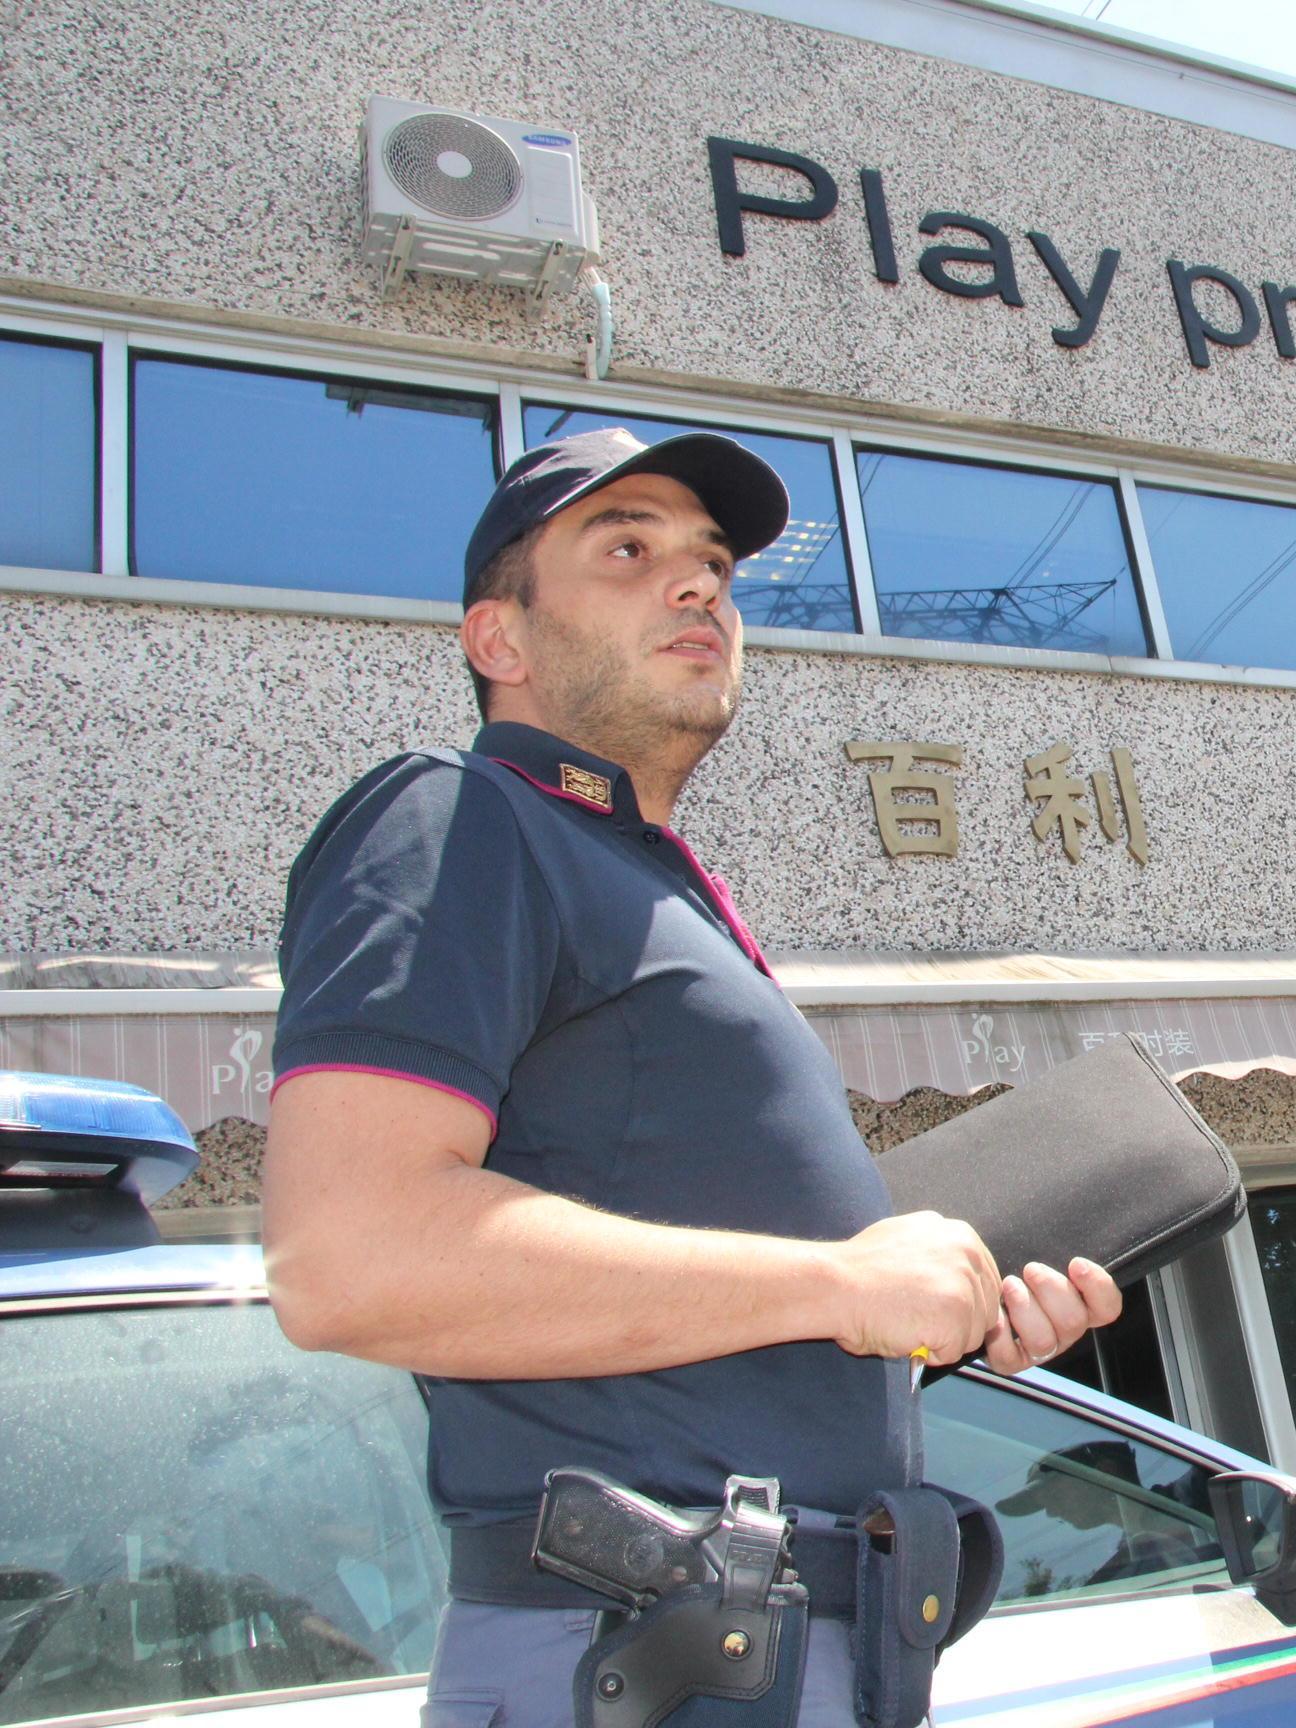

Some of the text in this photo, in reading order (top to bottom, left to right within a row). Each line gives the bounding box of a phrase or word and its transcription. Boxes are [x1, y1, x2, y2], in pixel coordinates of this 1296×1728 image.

[709, 136, 1121, 348] Play
[843, 741, 1149, 866] 百利
[211, 1027, 276, 1094] Pla
[961, 1013, 1026, 1072] Play
[1079, 1028, 1194, 1057] 百时装
